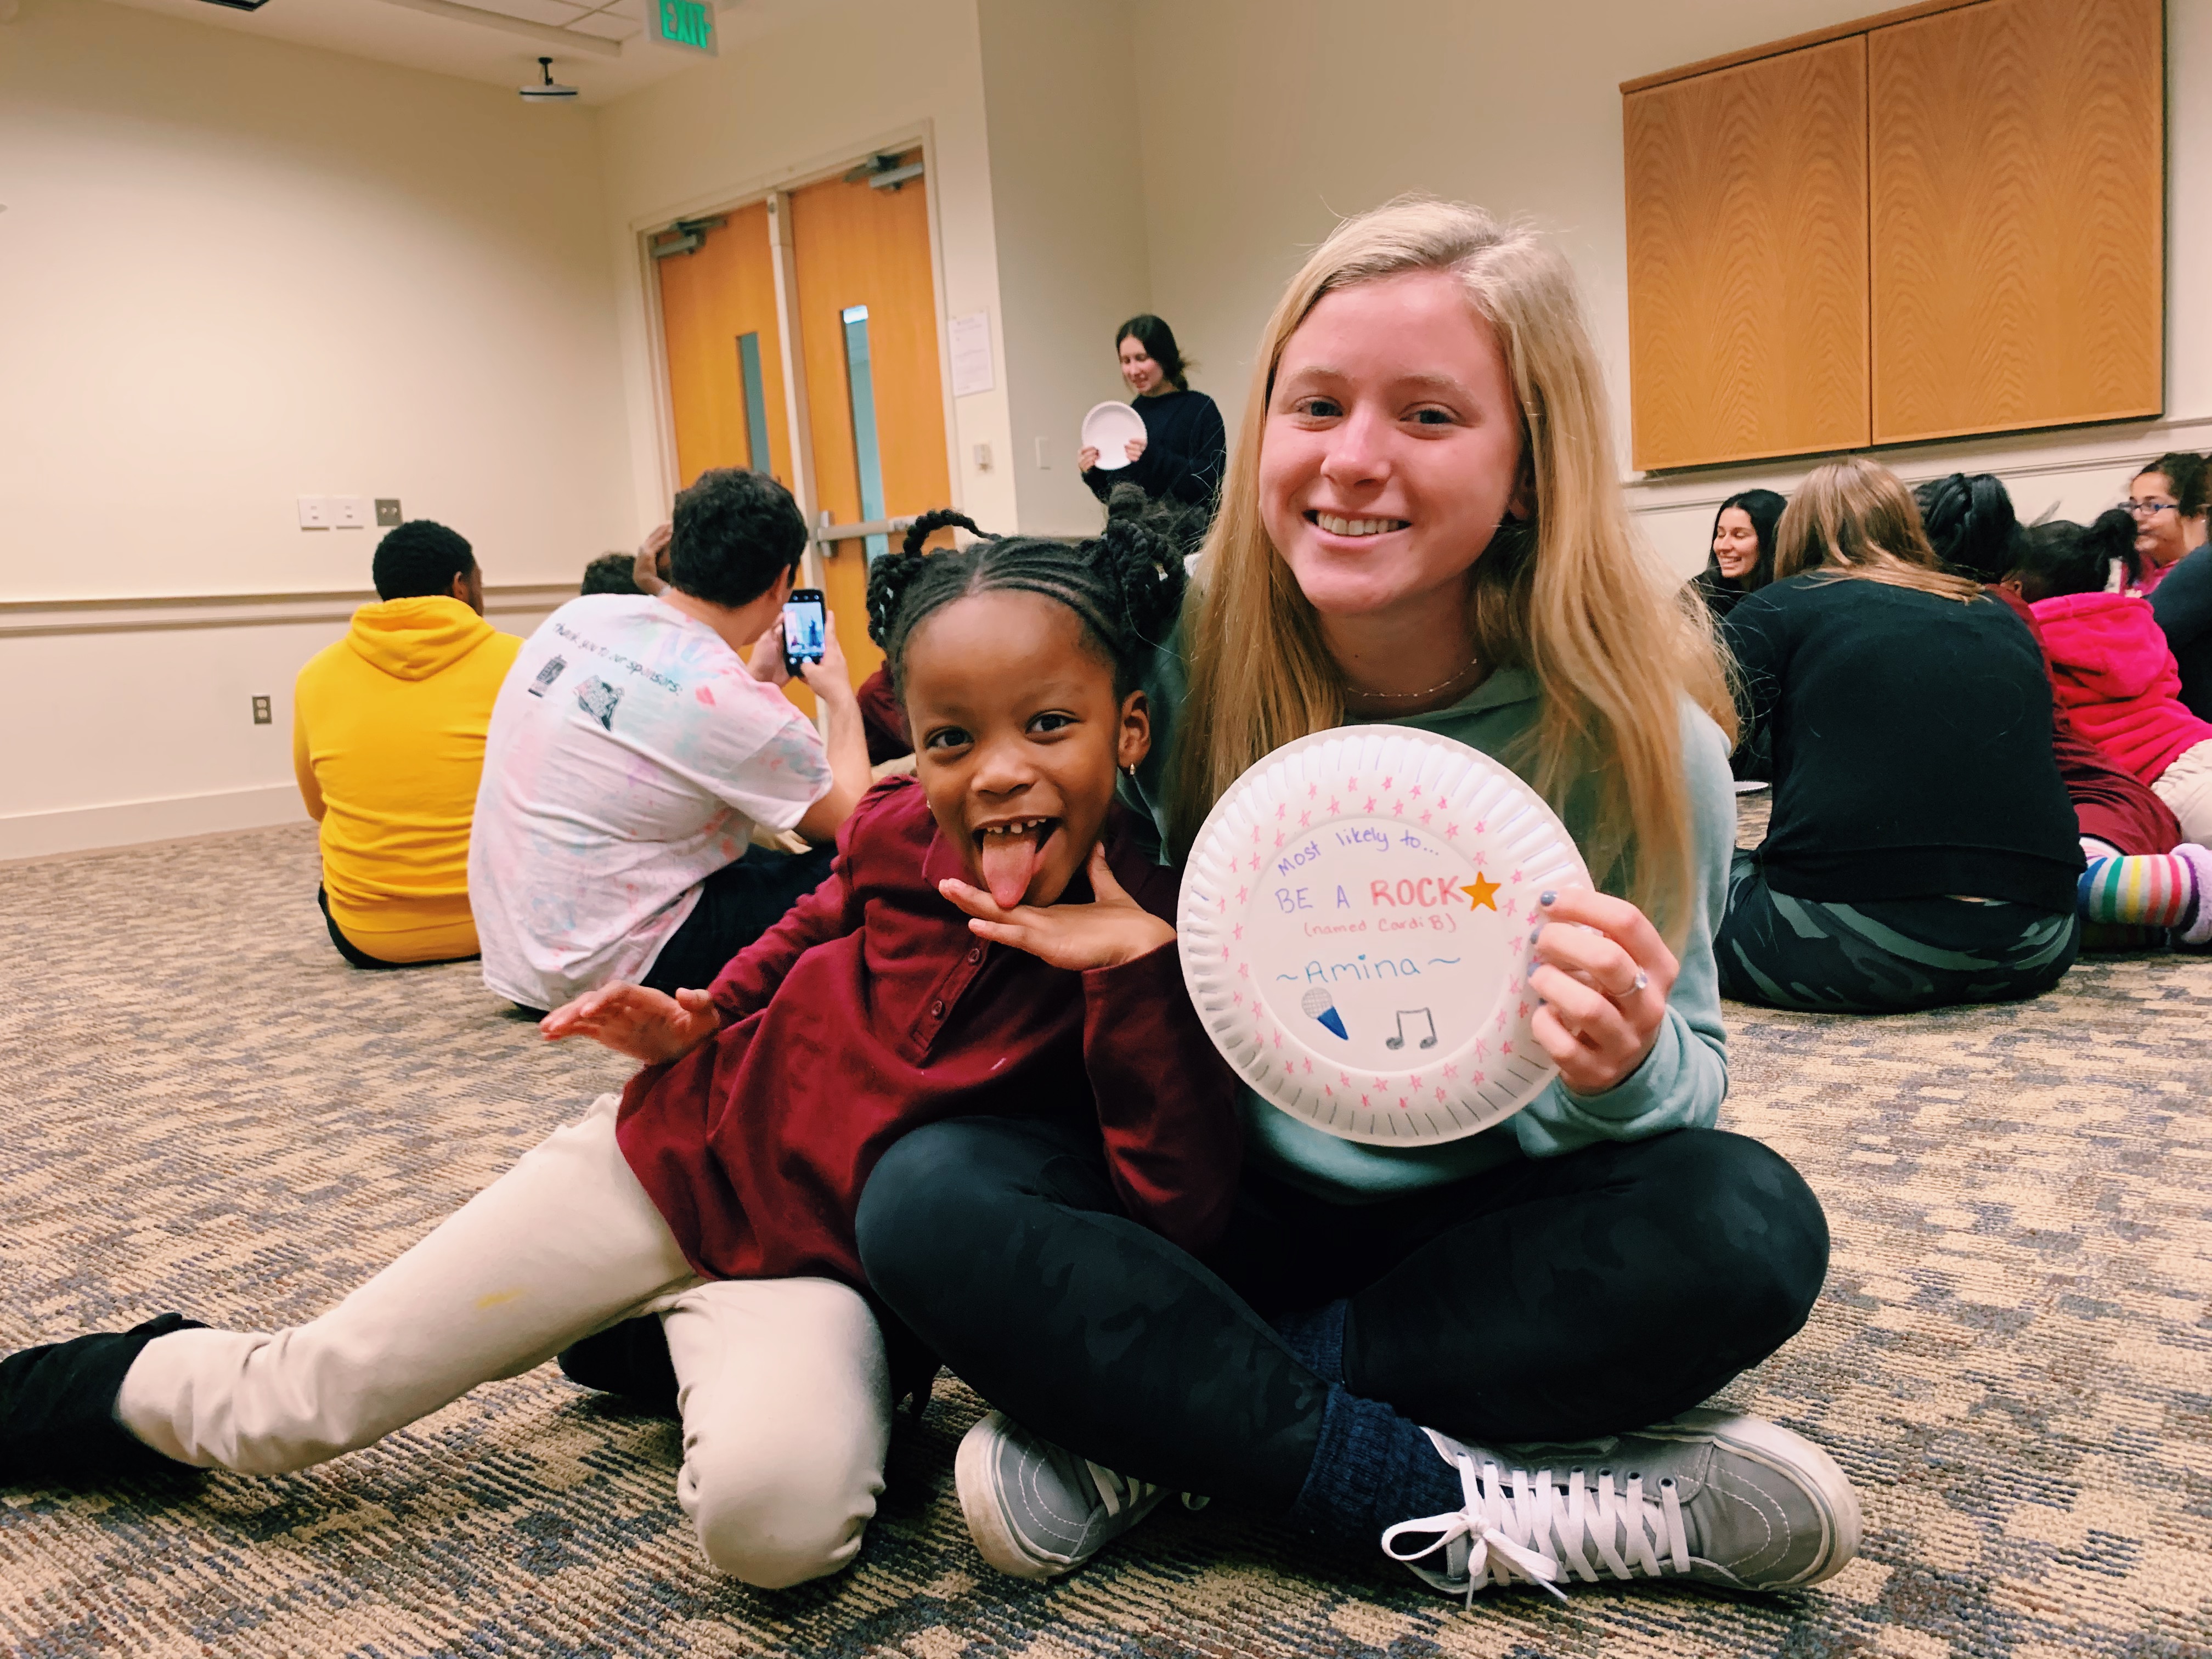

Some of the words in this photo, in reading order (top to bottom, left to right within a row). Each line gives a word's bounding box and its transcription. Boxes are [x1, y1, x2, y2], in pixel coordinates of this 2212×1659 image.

[659, 0, 707, 49] EXIT
[1278, 840, 1321, 877] Most
[1335, 827, 1389, 852] likely
[1274, 887, 1313, 914] BE
[1336, 884, 1351, 909] A
[1370, 875, 1465, 907] ROCK
[1304, 919, 1367, 938] (named
[1378, 916, 1424, 932] Cardi
